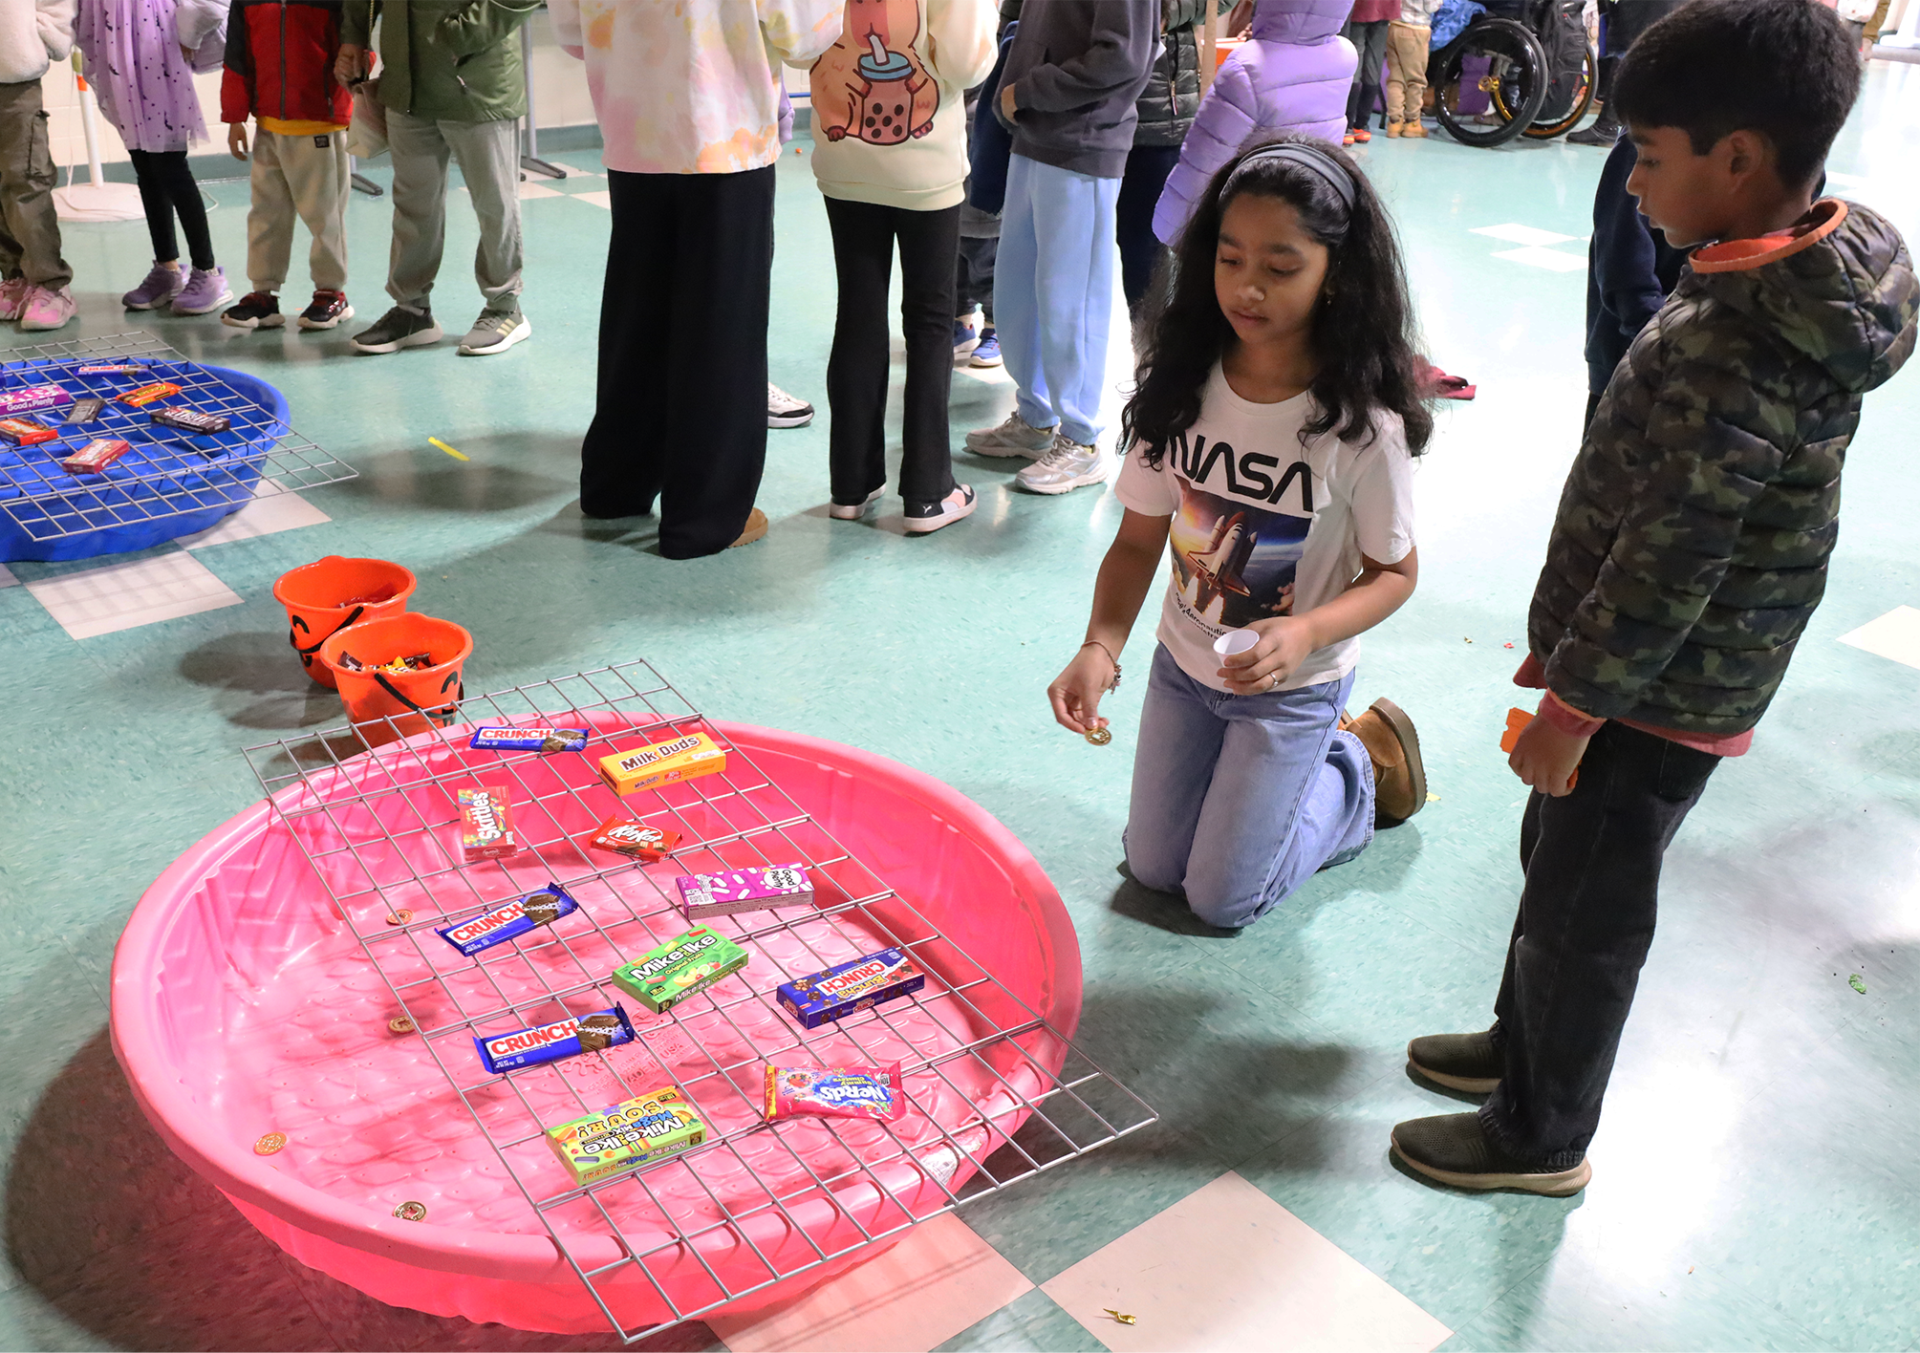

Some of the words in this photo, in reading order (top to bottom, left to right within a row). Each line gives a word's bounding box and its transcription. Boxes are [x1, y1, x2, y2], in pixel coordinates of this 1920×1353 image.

[7, 402, 28, 411] Good
[32, 397, 56, 407] Plenty
[1169, 431, 1314, 513] NASA
[1185, 608, 1227, 636] Aeronautic
[481, 729, 551, 739] CRUNCH
[619, 750, 659, 771] Milk
[656, 736, 699, 757] Duds
[470, 792, 502, 839] Skittles
[770, 870, 785, 889] Plenty
[782, 869, 796, 886] Good
[453, 904, 525, 941] CRUNCH
[629, 950, 684, 980] Mike
[682, 934, 718, 955] Ike
[664, 960, 689, 975] Original
[689, 952, 705, 963] Fruits
[820, 962, 886, 993] CRUNCH
[491, 1020, 578, 1055] CRUNCH
[660, 1042, 684, 1059] USA
[625, 1116, 685, 1139] Mike
[631, 1110, 673, 1128] Mega
[583, 1137, 622, 1155] Ike
